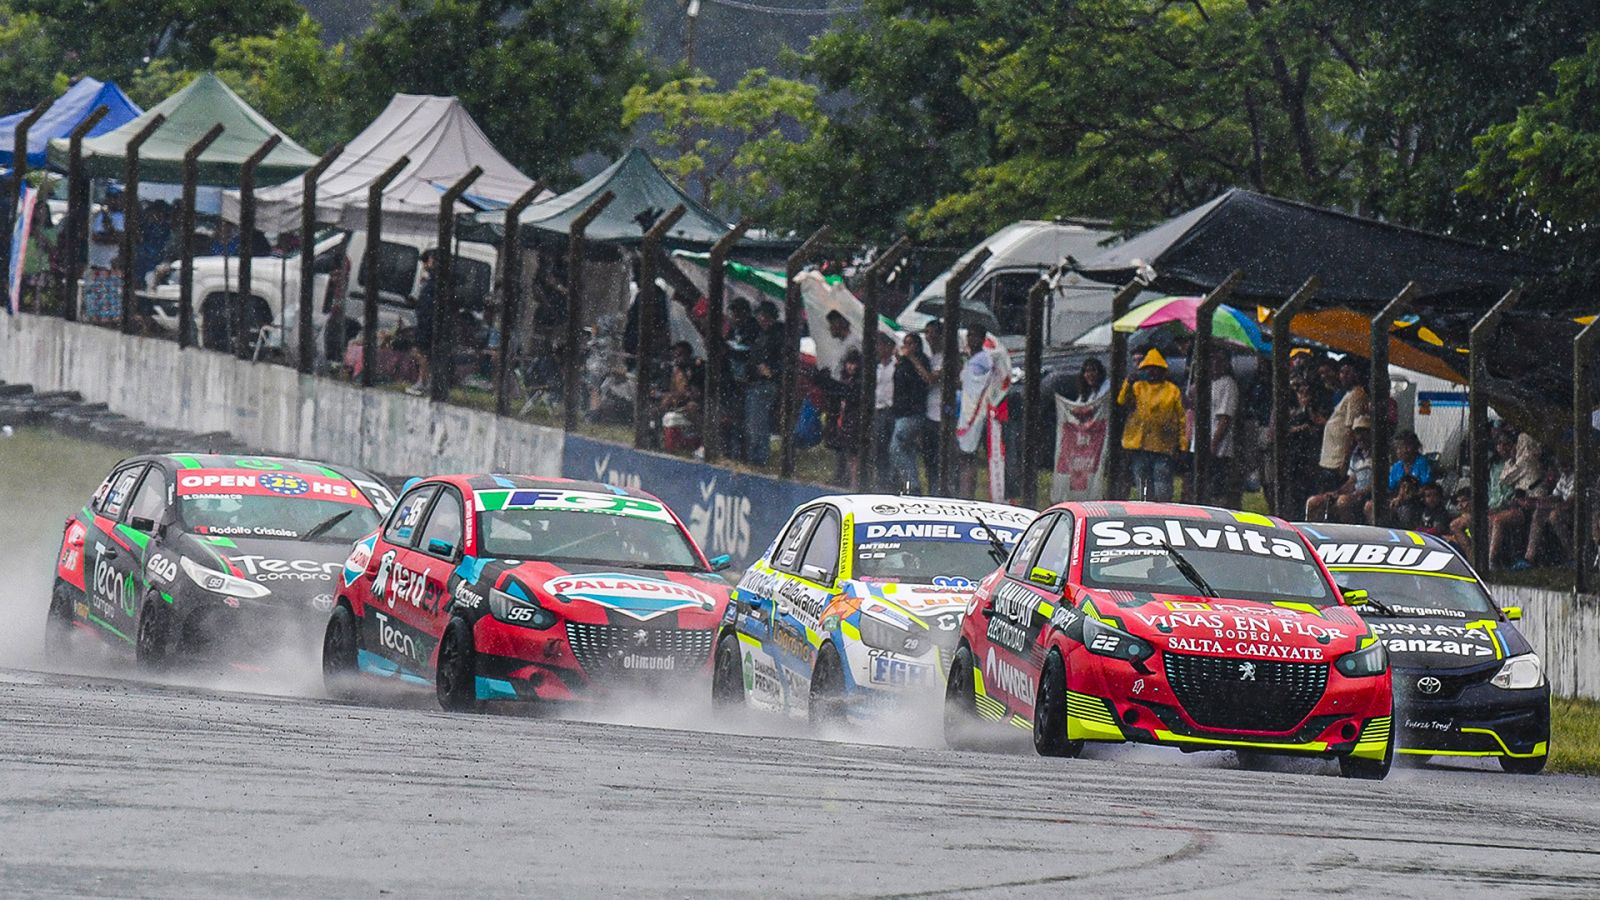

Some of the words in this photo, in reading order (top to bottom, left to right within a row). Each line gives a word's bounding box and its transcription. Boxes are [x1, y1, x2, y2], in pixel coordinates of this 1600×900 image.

[181, 474, 256, 488] OPEN
[271, 476, 299, 490] 25
[209, 526, 251, 535] Rodolfo
[253, 527, 298, 537] Cristales
[713, 493, 751, 558] RUS
[867, 525, 961, 539] DANIEL
[1091, 519, 1305, 561] Salvita
[208, 577, 223, 588] 99
[255, 572, 331, 582] compro
[507, 607, 535, 621] 95
[1392, 604, 1466, 617] Pergamino
[1134, 611, 1224, 628] VIÑAS
[1232, 616, 1271, 632] EN
[1280, 618, 1349, 640] FLOR
[1090, 633, 1121, 651] 22
[1214, 629, 1282, 642] BODEGA
[1168, 636, 1224, 654] SALTA
[1235, 641, 1323, 660] CAFAYATE
